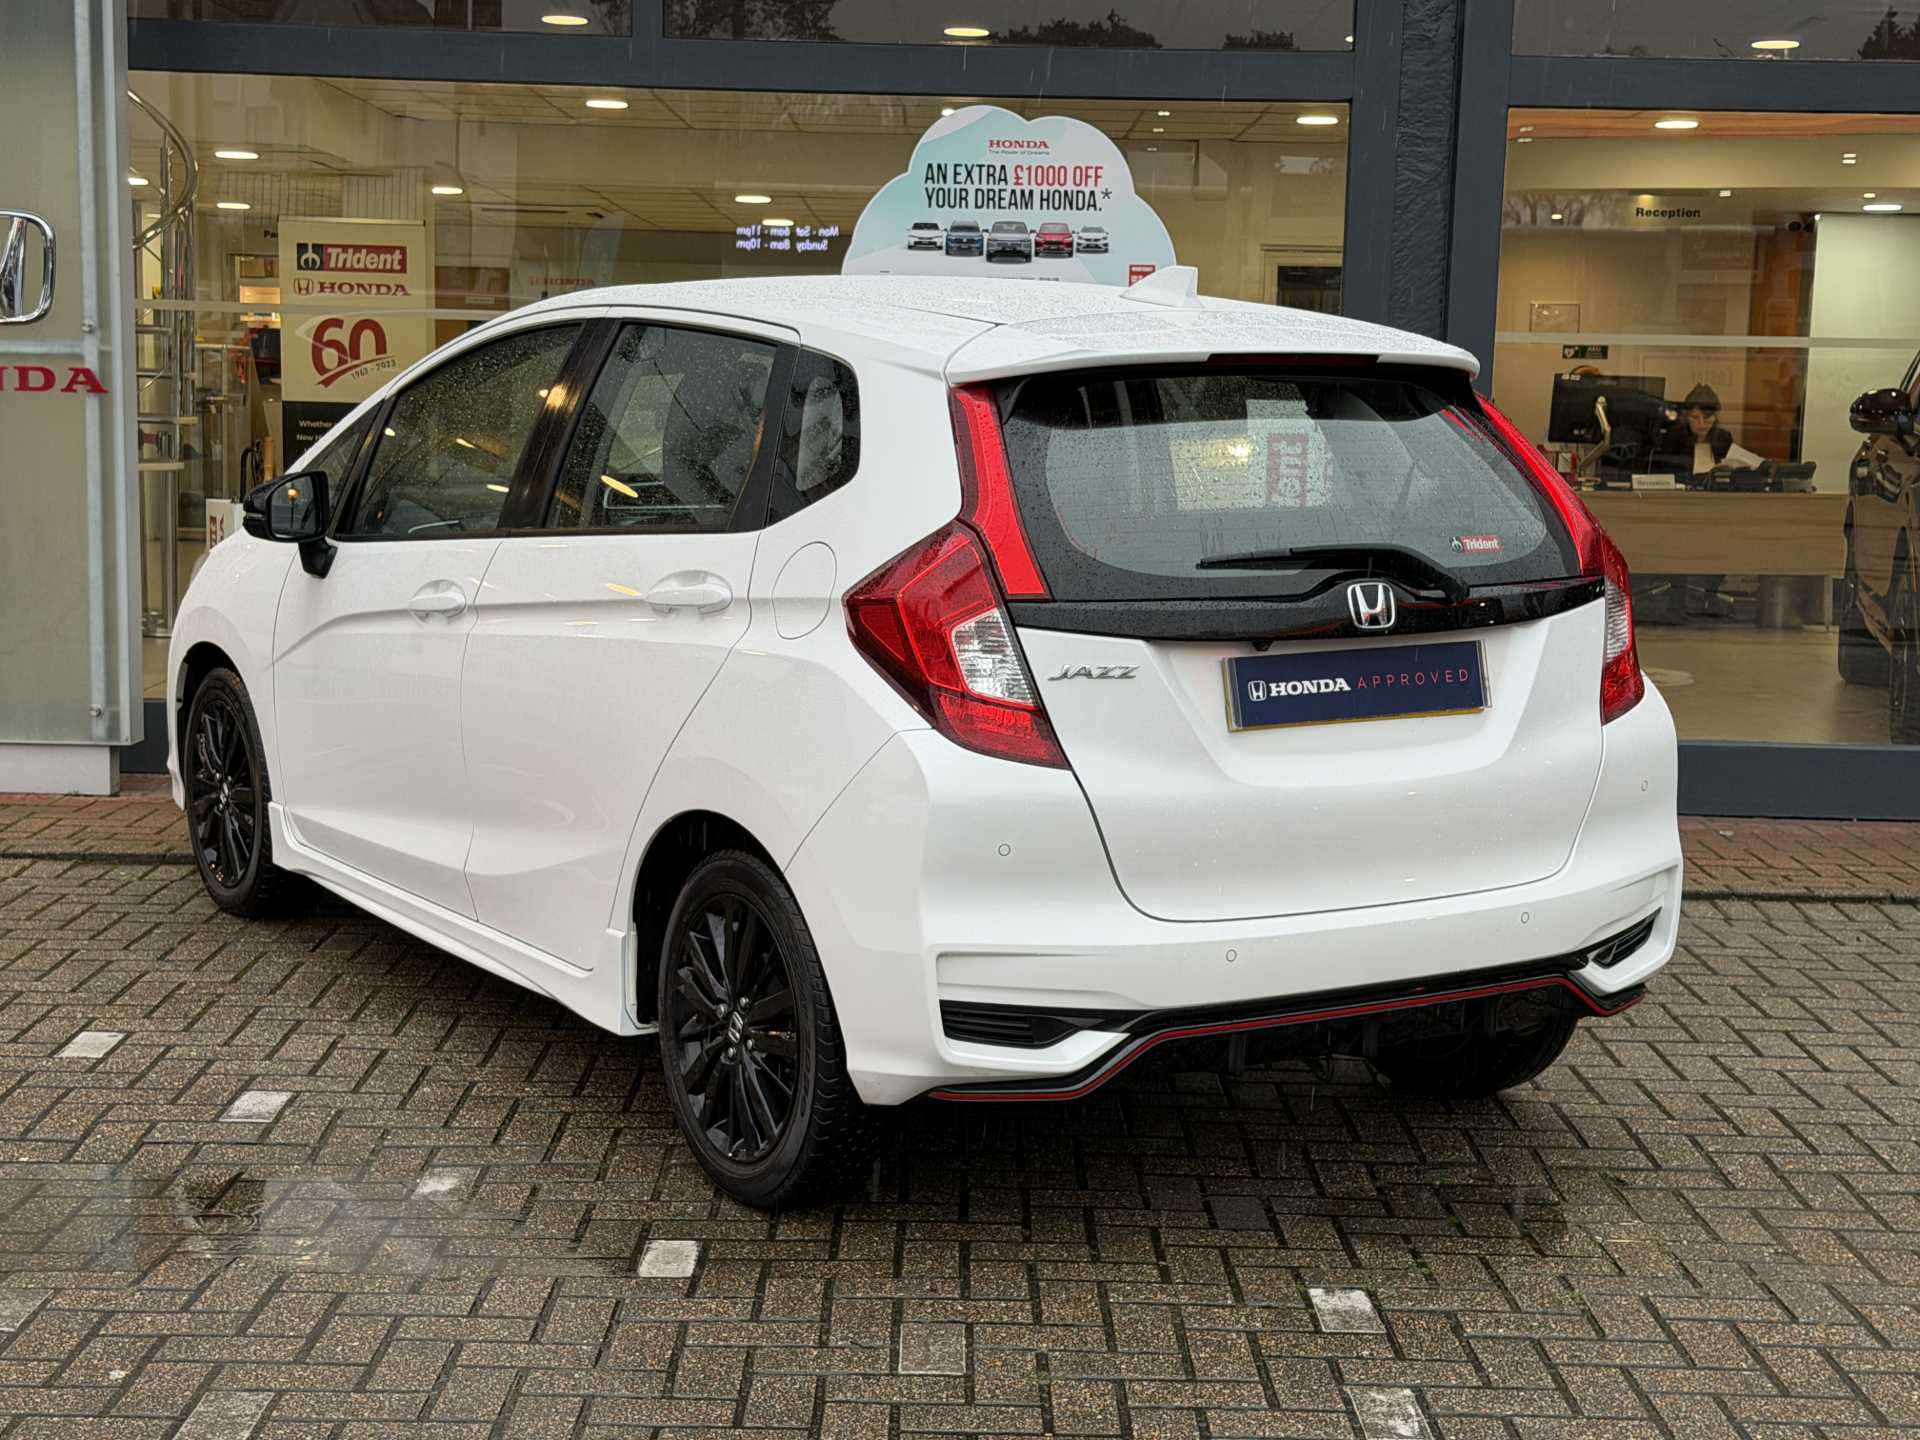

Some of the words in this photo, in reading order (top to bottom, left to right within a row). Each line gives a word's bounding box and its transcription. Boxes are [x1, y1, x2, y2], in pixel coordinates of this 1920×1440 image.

[989, 139, 1049, 149] HONDA
[924, 163, 947, 185] AN
[953, 164, 1008, 186] EXTRA
[1013, 164, 1068, 187] £1000
[1072, 166, 1104, 187] OFF
[925, 187, 969, 209] YOUR
[975, 188, 1033, 210] DREAM
[1636, 208, 1701, 219] Reception
[327, 247, 402, 271] Trident
[318, 281, 411, 296] HONDA
[312, 318, 387, 376] 60
[299, 419, 333, 429] Whether
[1463, 538, 1500, 551] Trident
[1047, 665, 1141, 682] JAZZ
[1269, 677, 1352, 697] HONDA
[1358, 668, 1470, 690] APPROVED
